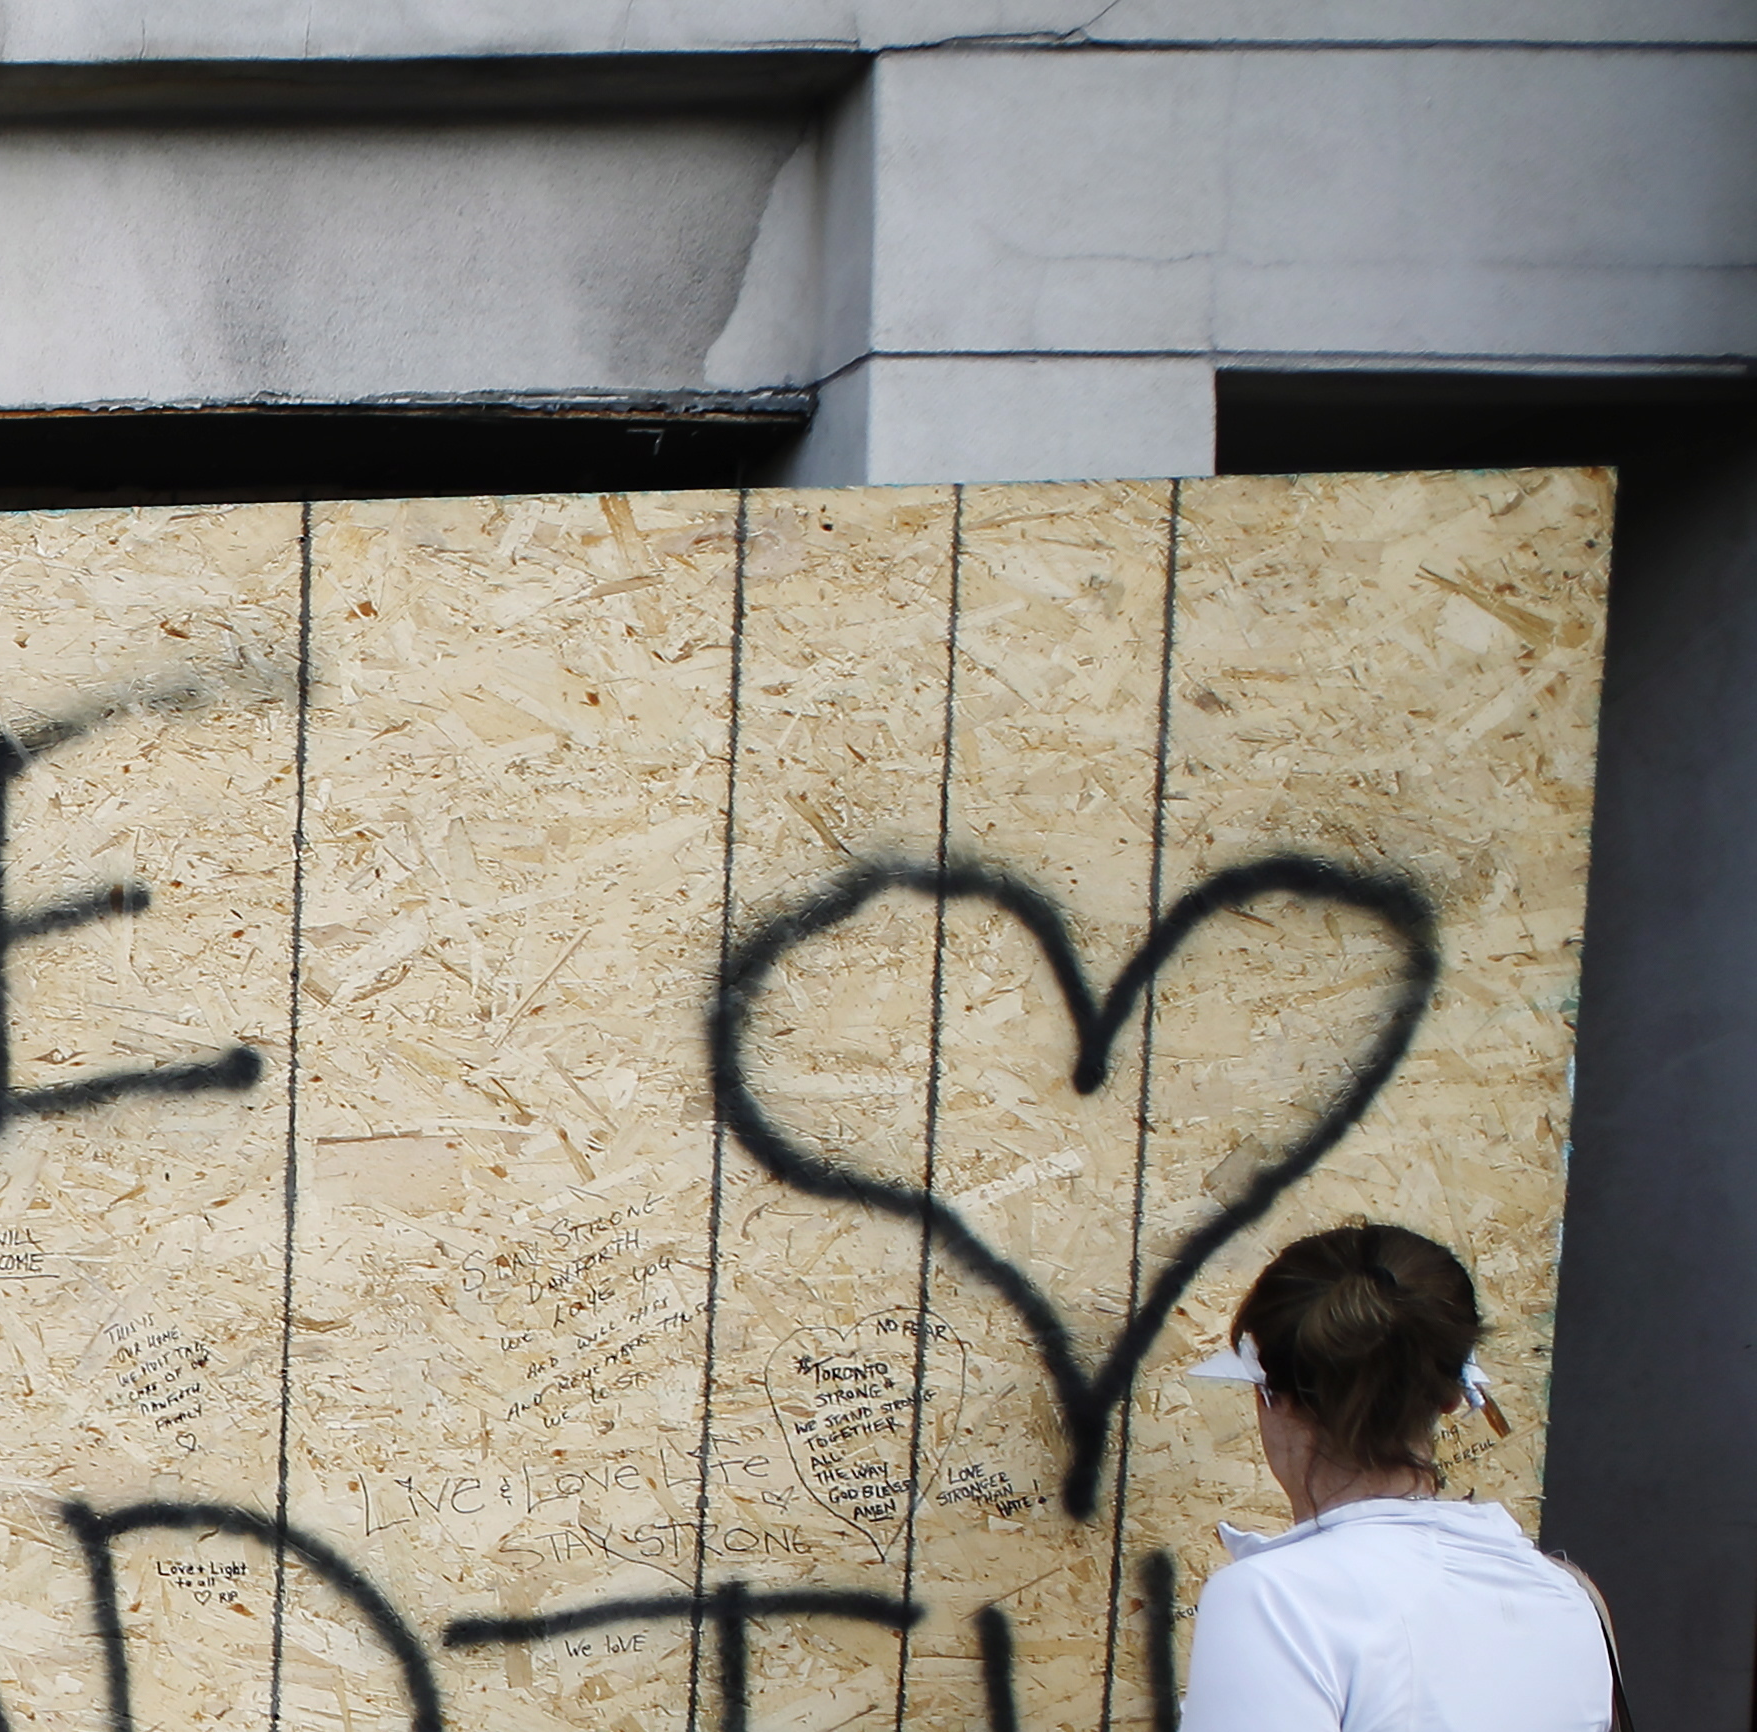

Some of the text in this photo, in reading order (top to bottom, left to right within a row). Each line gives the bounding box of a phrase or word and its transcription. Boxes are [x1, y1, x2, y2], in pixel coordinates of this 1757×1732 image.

[876, 1319, 898, 1334] NO
[948, 1462, 985, 1484] LOVE
[853, 1499, 897, 1521] AMEN
[499, 1522, 814, 1568] STAY STRONG
[157, 1561, 247, 1579] Love Light
[176, 1577, 214, 1588] to all
